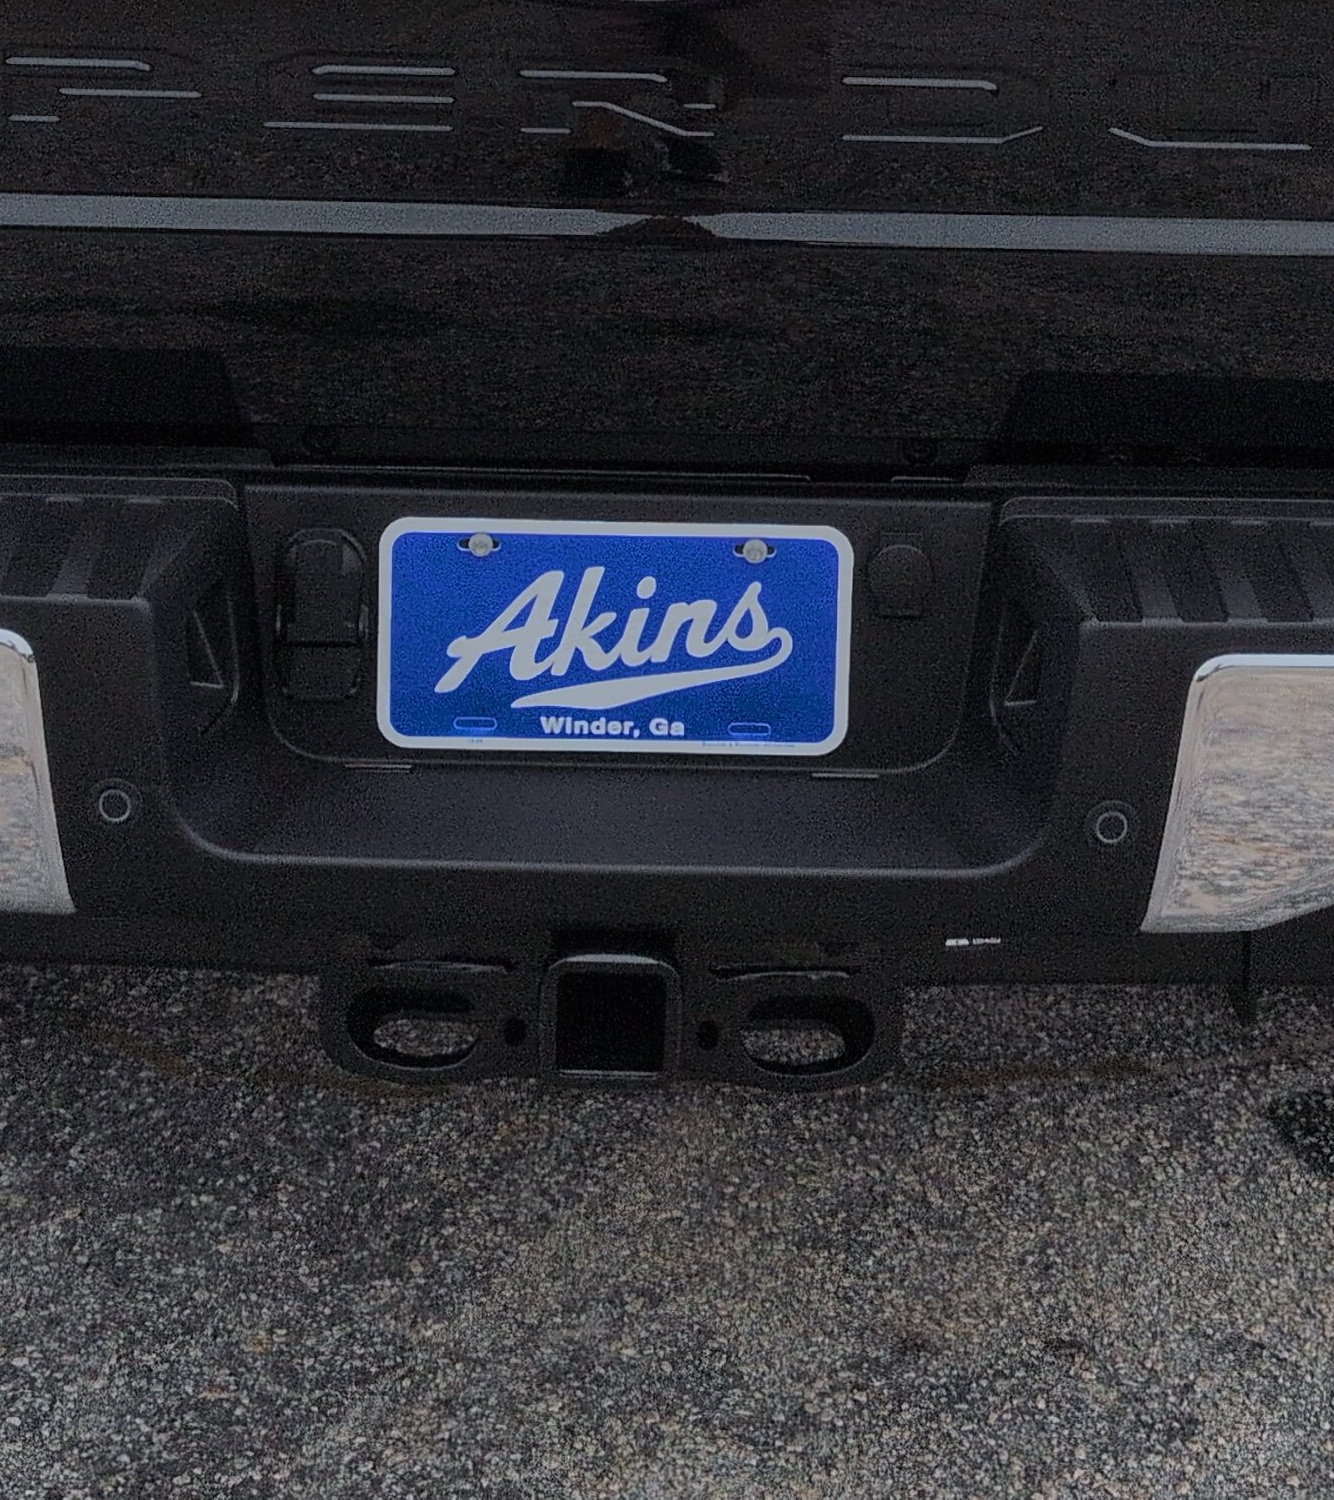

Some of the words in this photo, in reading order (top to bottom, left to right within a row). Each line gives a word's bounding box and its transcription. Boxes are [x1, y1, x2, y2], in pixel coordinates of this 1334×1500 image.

[433, 566, 793, 709] Akins
[539, 715, 640, 739] Winder,
[648, 717, 685, 737] Ga
